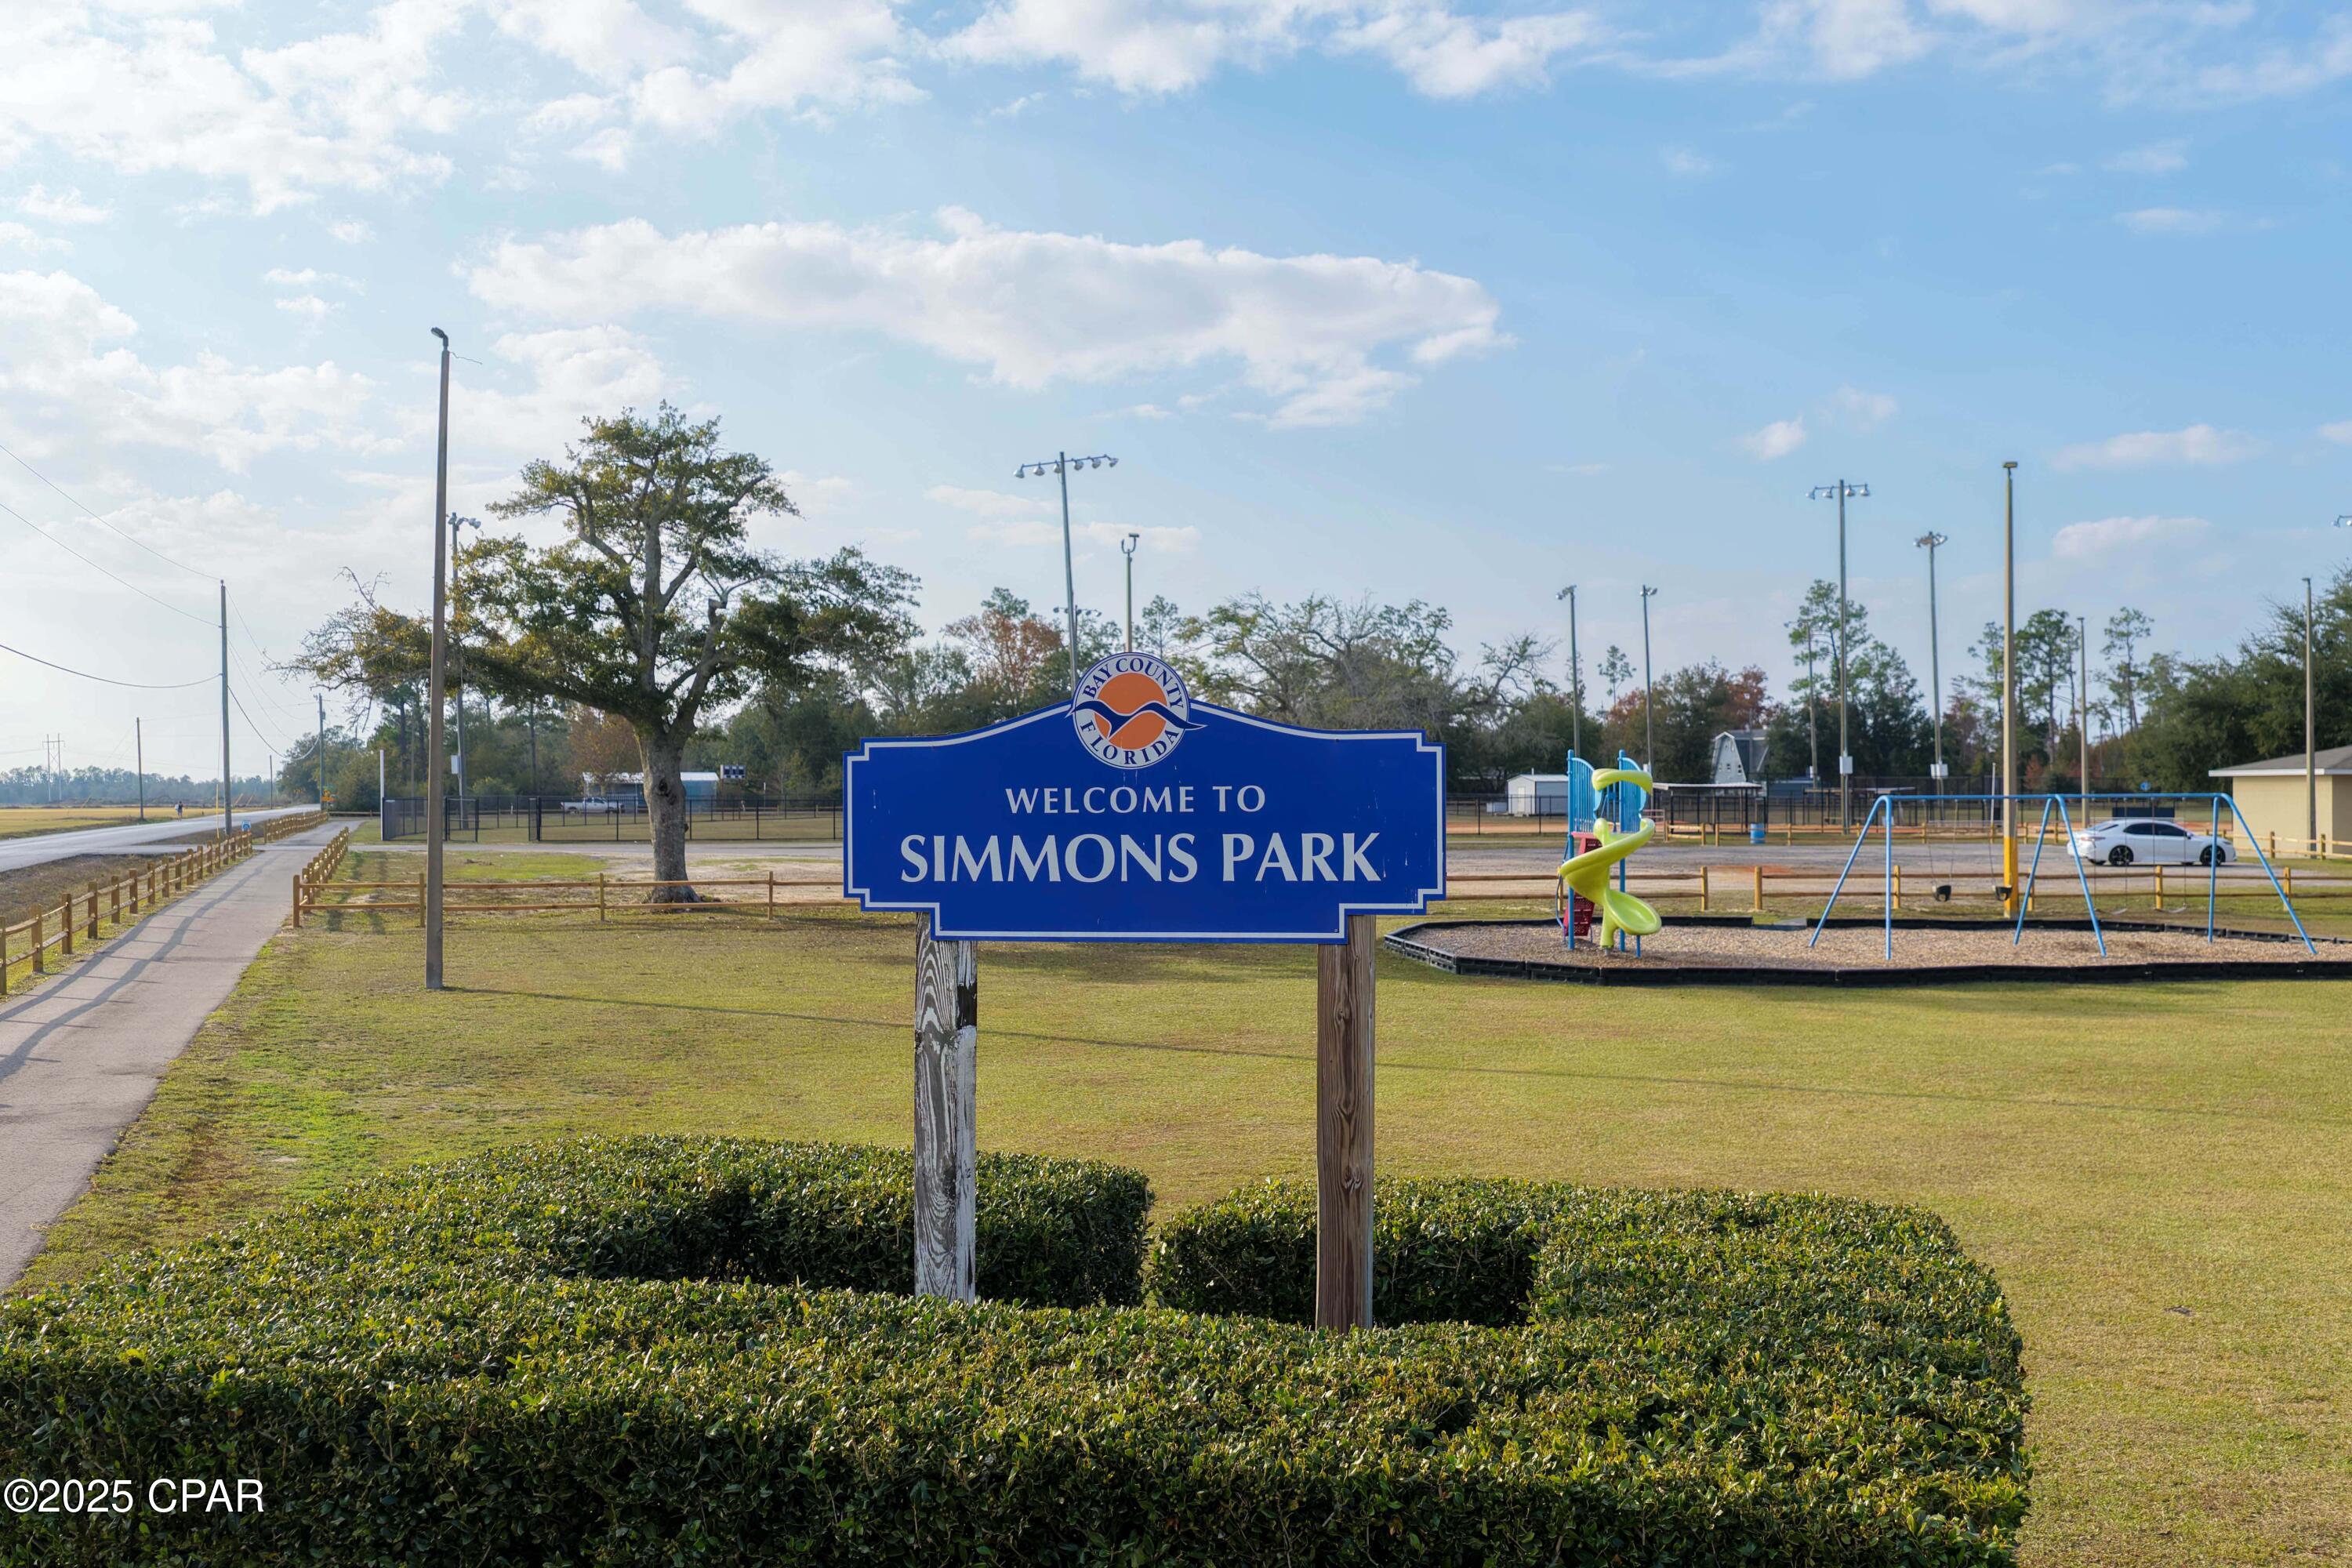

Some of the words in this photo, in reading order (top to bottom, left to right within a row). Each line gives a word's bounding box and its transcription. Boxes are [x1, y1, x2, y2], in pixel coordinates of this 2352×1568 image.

[1083, 663, 1112, 699] BAY
[1116, 658, 1184, 708] COUNTY
[1080, 720, 1180, 765] FLORIDA
[1005, 787, 1194, 814] WELCOME
[1212, 785, 1265, 812] TO
[900, 833, 1198, 883] SIMMONS
[1222, 832, 1381, 882] PARK
